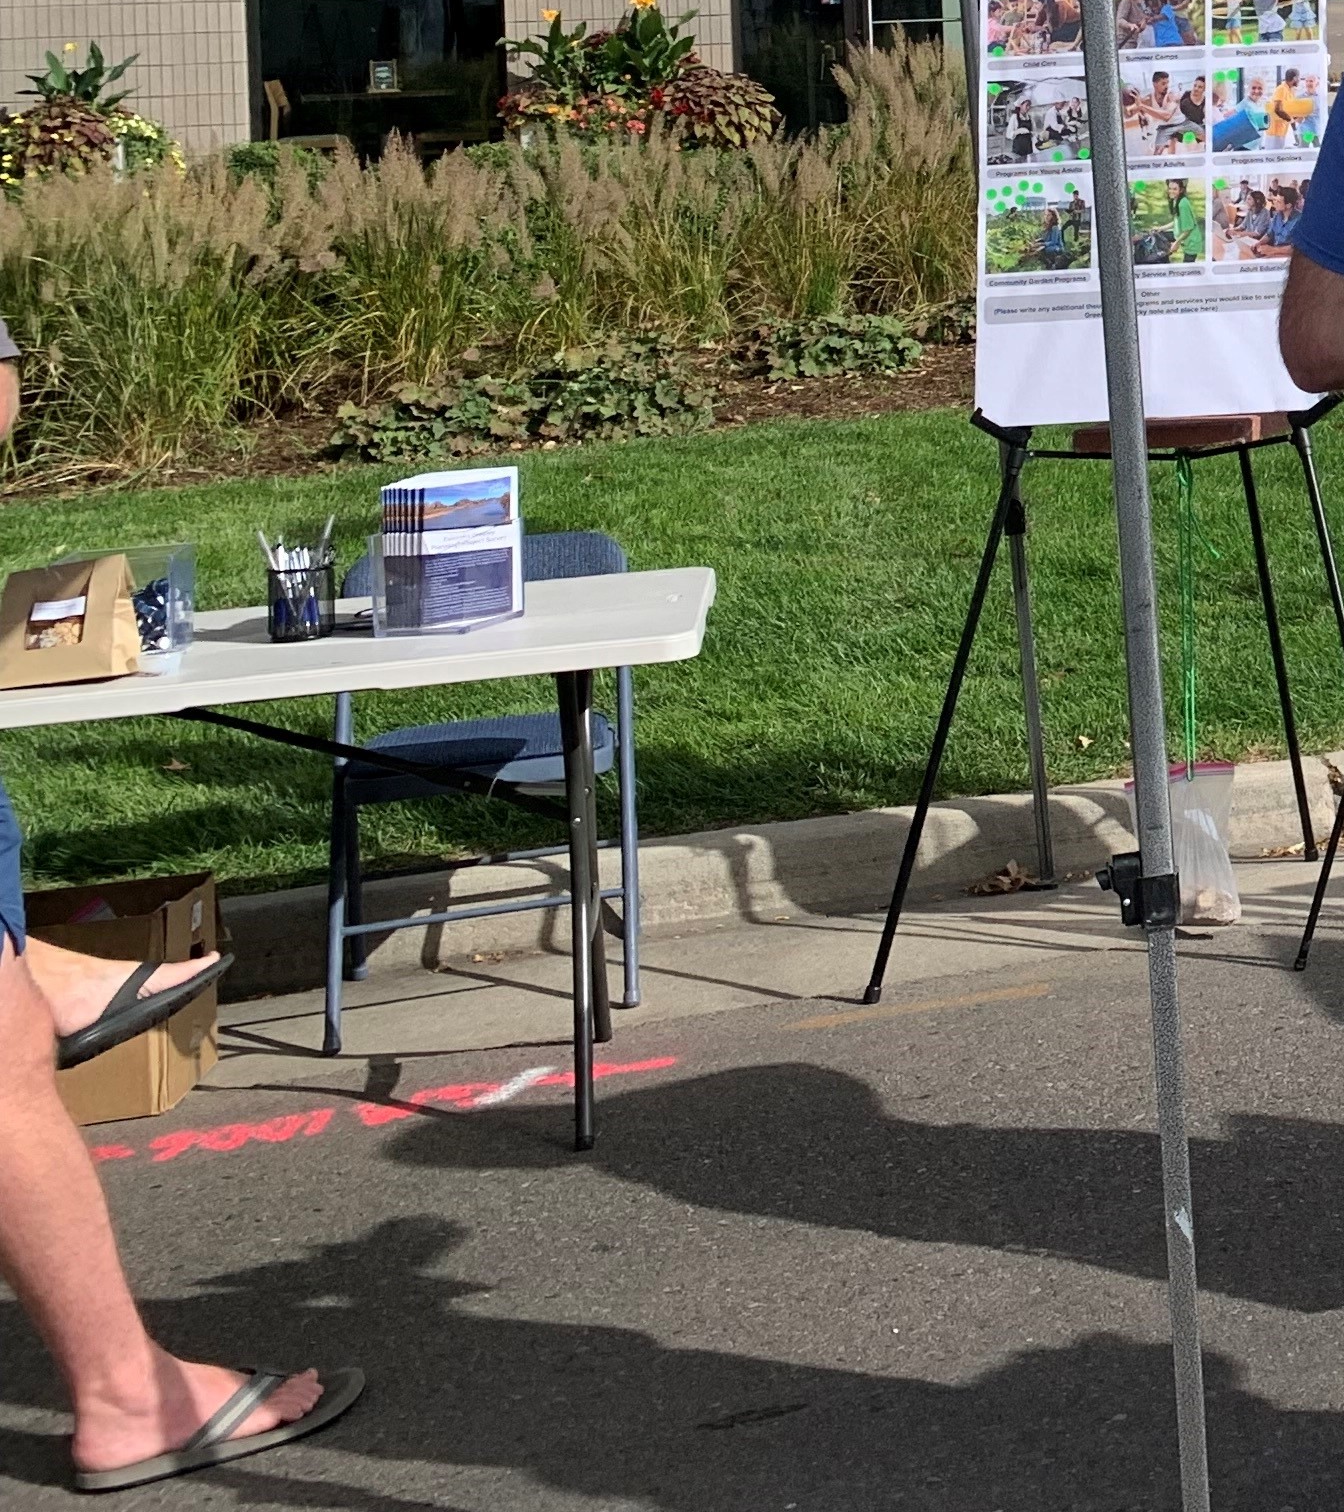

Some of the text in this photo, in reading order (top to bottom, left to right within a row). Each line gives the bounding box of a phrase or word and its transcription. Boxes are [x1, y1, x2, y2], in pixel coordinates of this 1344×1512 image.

[1155, 53, 1178, 61] Camps
[1236, 49, 1267, 57] Programs
[1231, 157, 1264, 165] Programs
[989, 279, 1027, 287] Community
[1054, 276, 1087, 284] Programs
